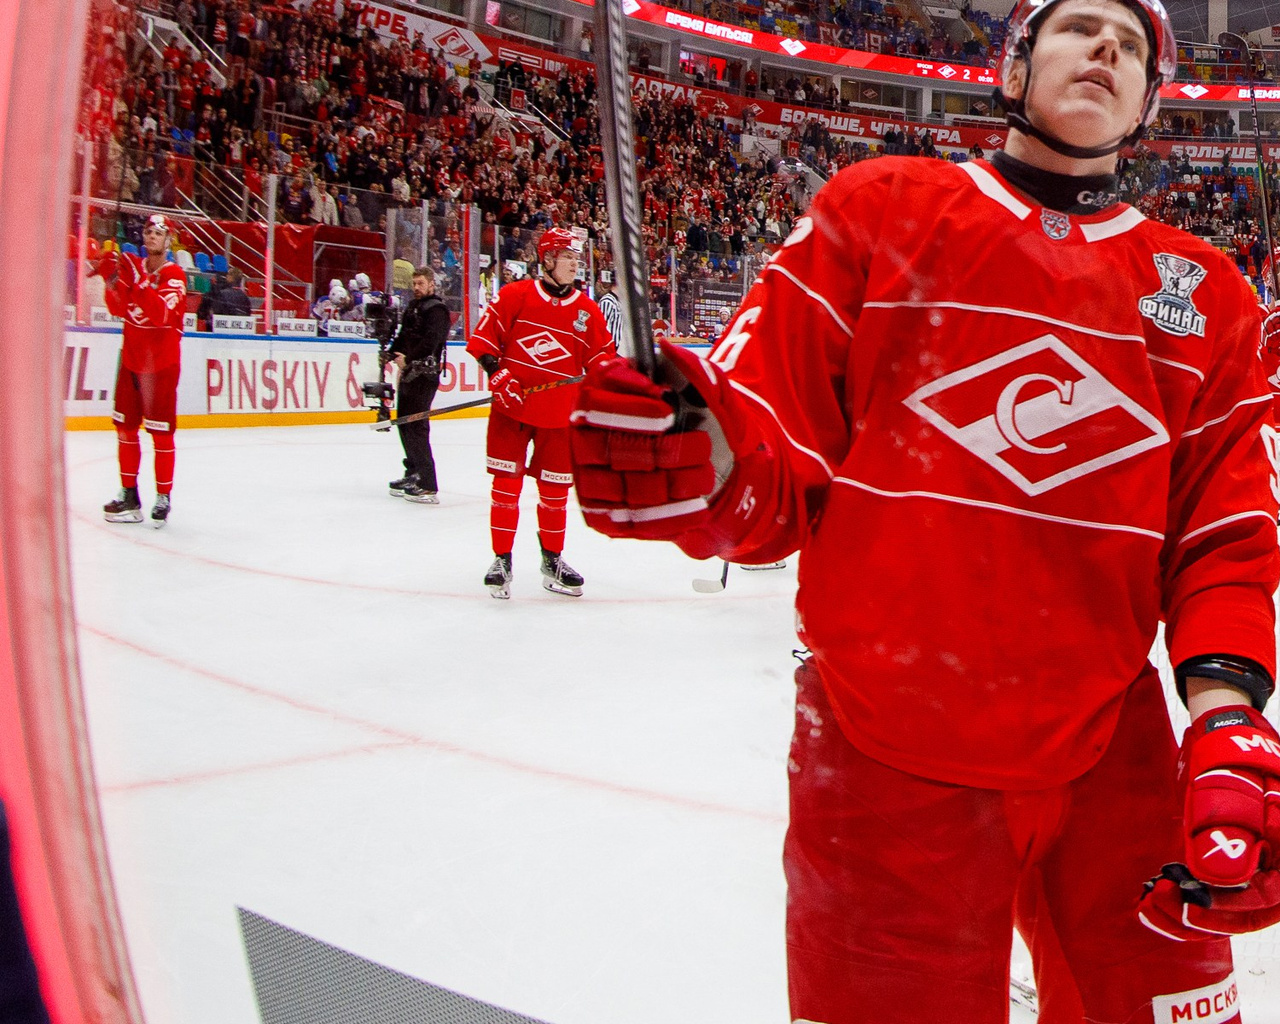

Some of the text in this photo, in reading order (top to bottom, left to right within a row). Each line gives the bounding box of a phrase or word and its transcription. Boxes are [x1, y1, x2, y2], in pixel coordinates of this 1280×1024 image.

[665, 11, 754, 44] ВРЕМЯ БИТЬСЯ!
[963, 69, 971, 80] 2
[629, 77, 702, 107] АРТАК
[1141, 298, 1205, 335] ФИНАЛ
[206, 358, 331, 413] PINSKIY
[1214, 718, 1244, 728] MACH
